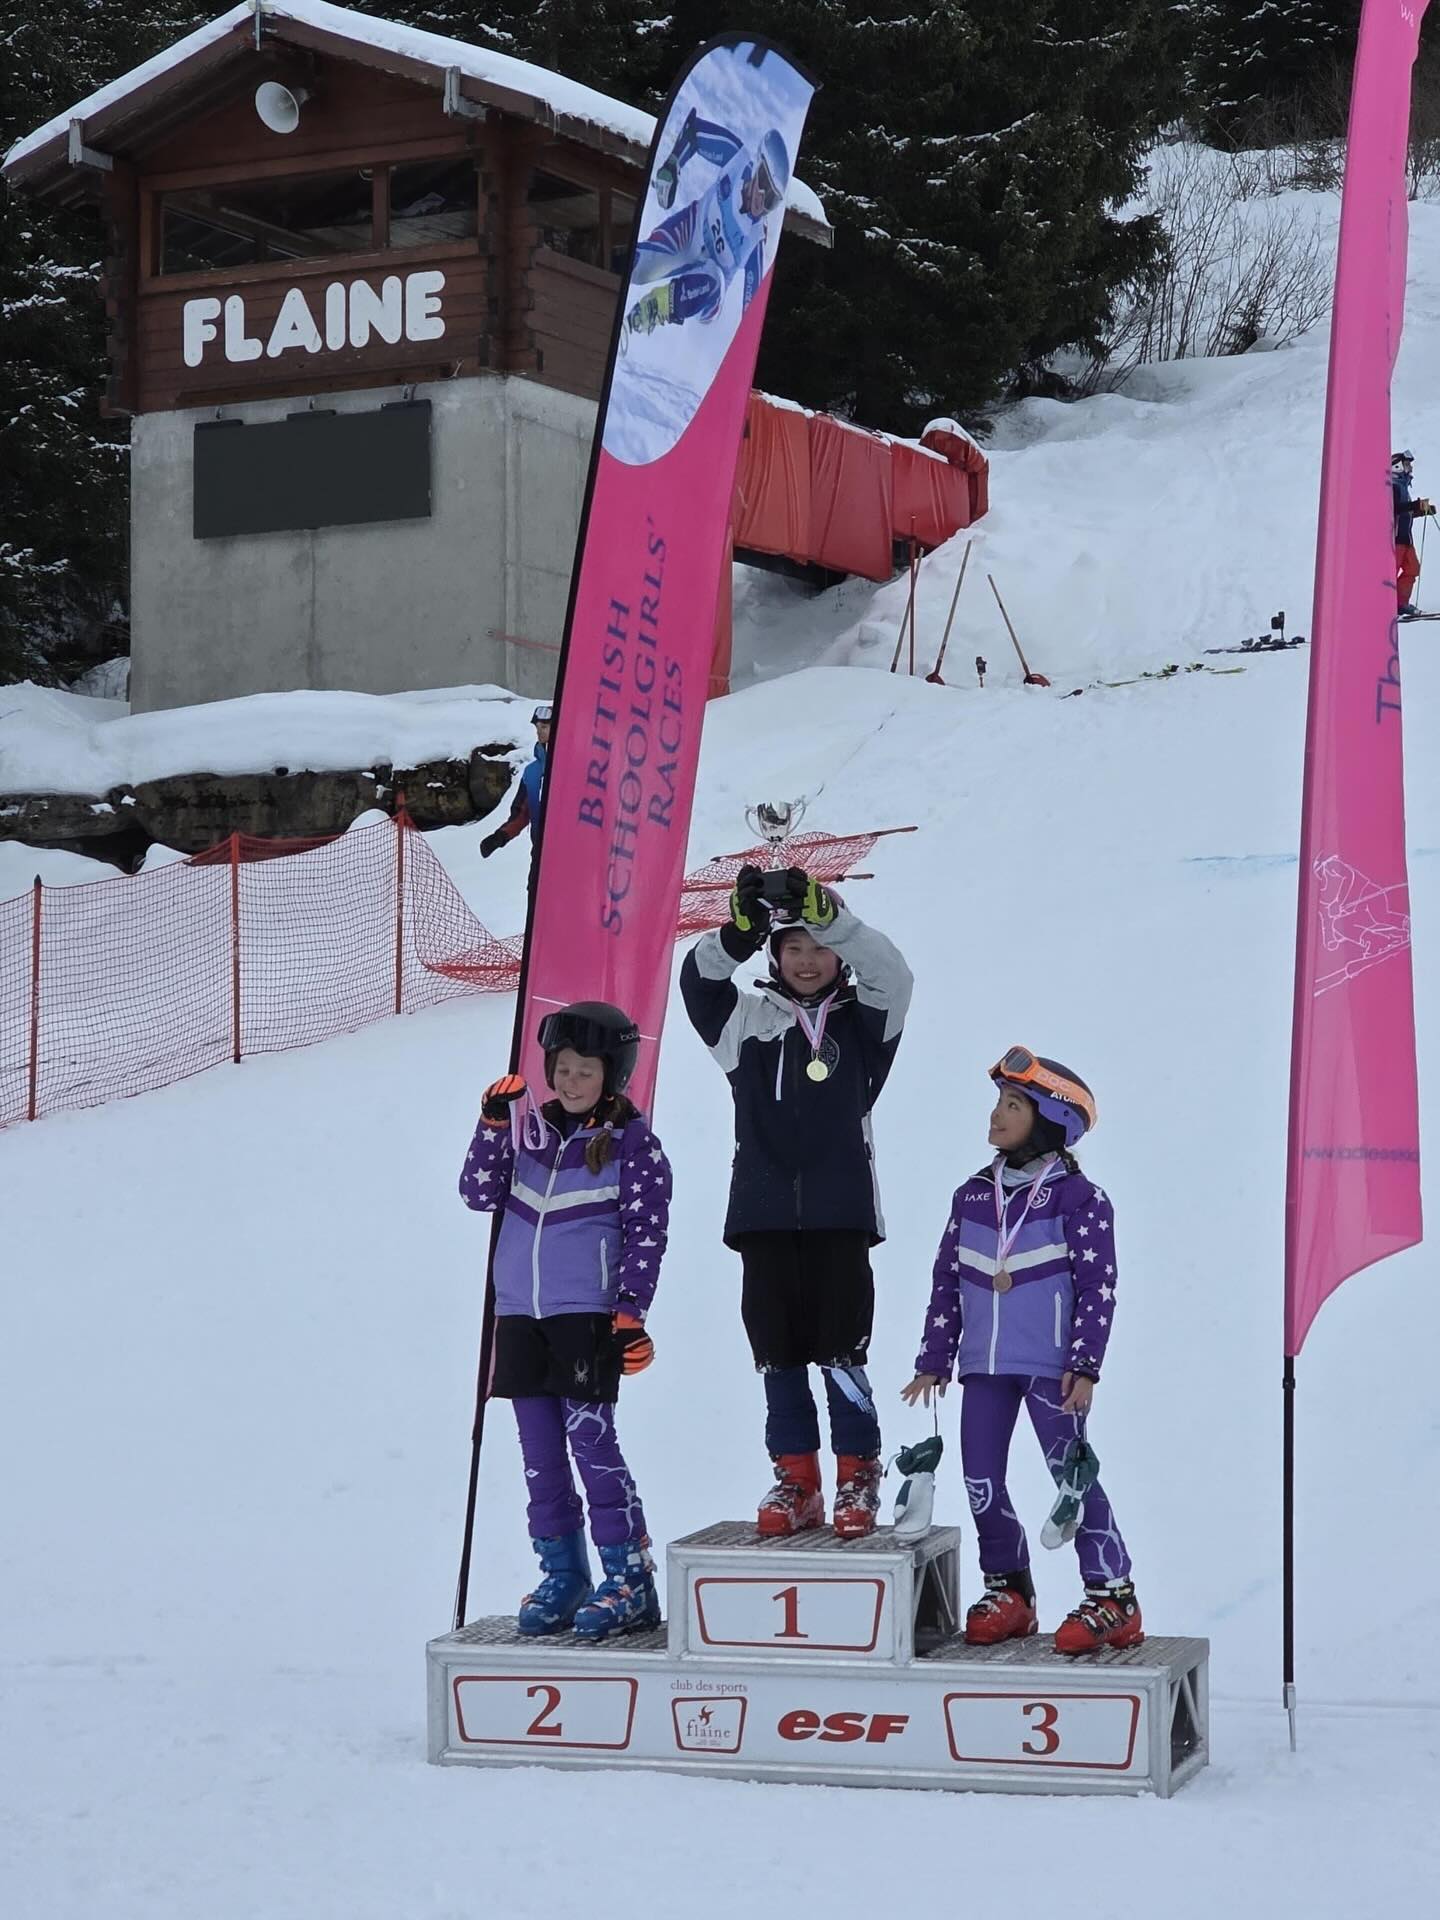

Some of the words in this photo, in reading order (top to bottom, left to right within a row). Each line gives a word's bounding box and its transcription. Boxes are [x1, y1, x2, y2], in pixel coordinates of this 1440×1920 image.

[183, 270, 446, 368] FLAINE
[578, 596, 630, 830] BRITISH
[602, 514, 666, 936] SCHOOLGIRLS'
[647, 654, 684, 830] RACES
[772, 1585, 810, 1639] 1
[526, 1684, 563, 1737] 2
[670, 1680, 693, 1690] club
[695, 1680, 713, 1691] des
[716, 1683, 748, 1695] sports
[686, 1719, 732, 1738] flaine
[1021, 1702, 1061, 1755] 3
